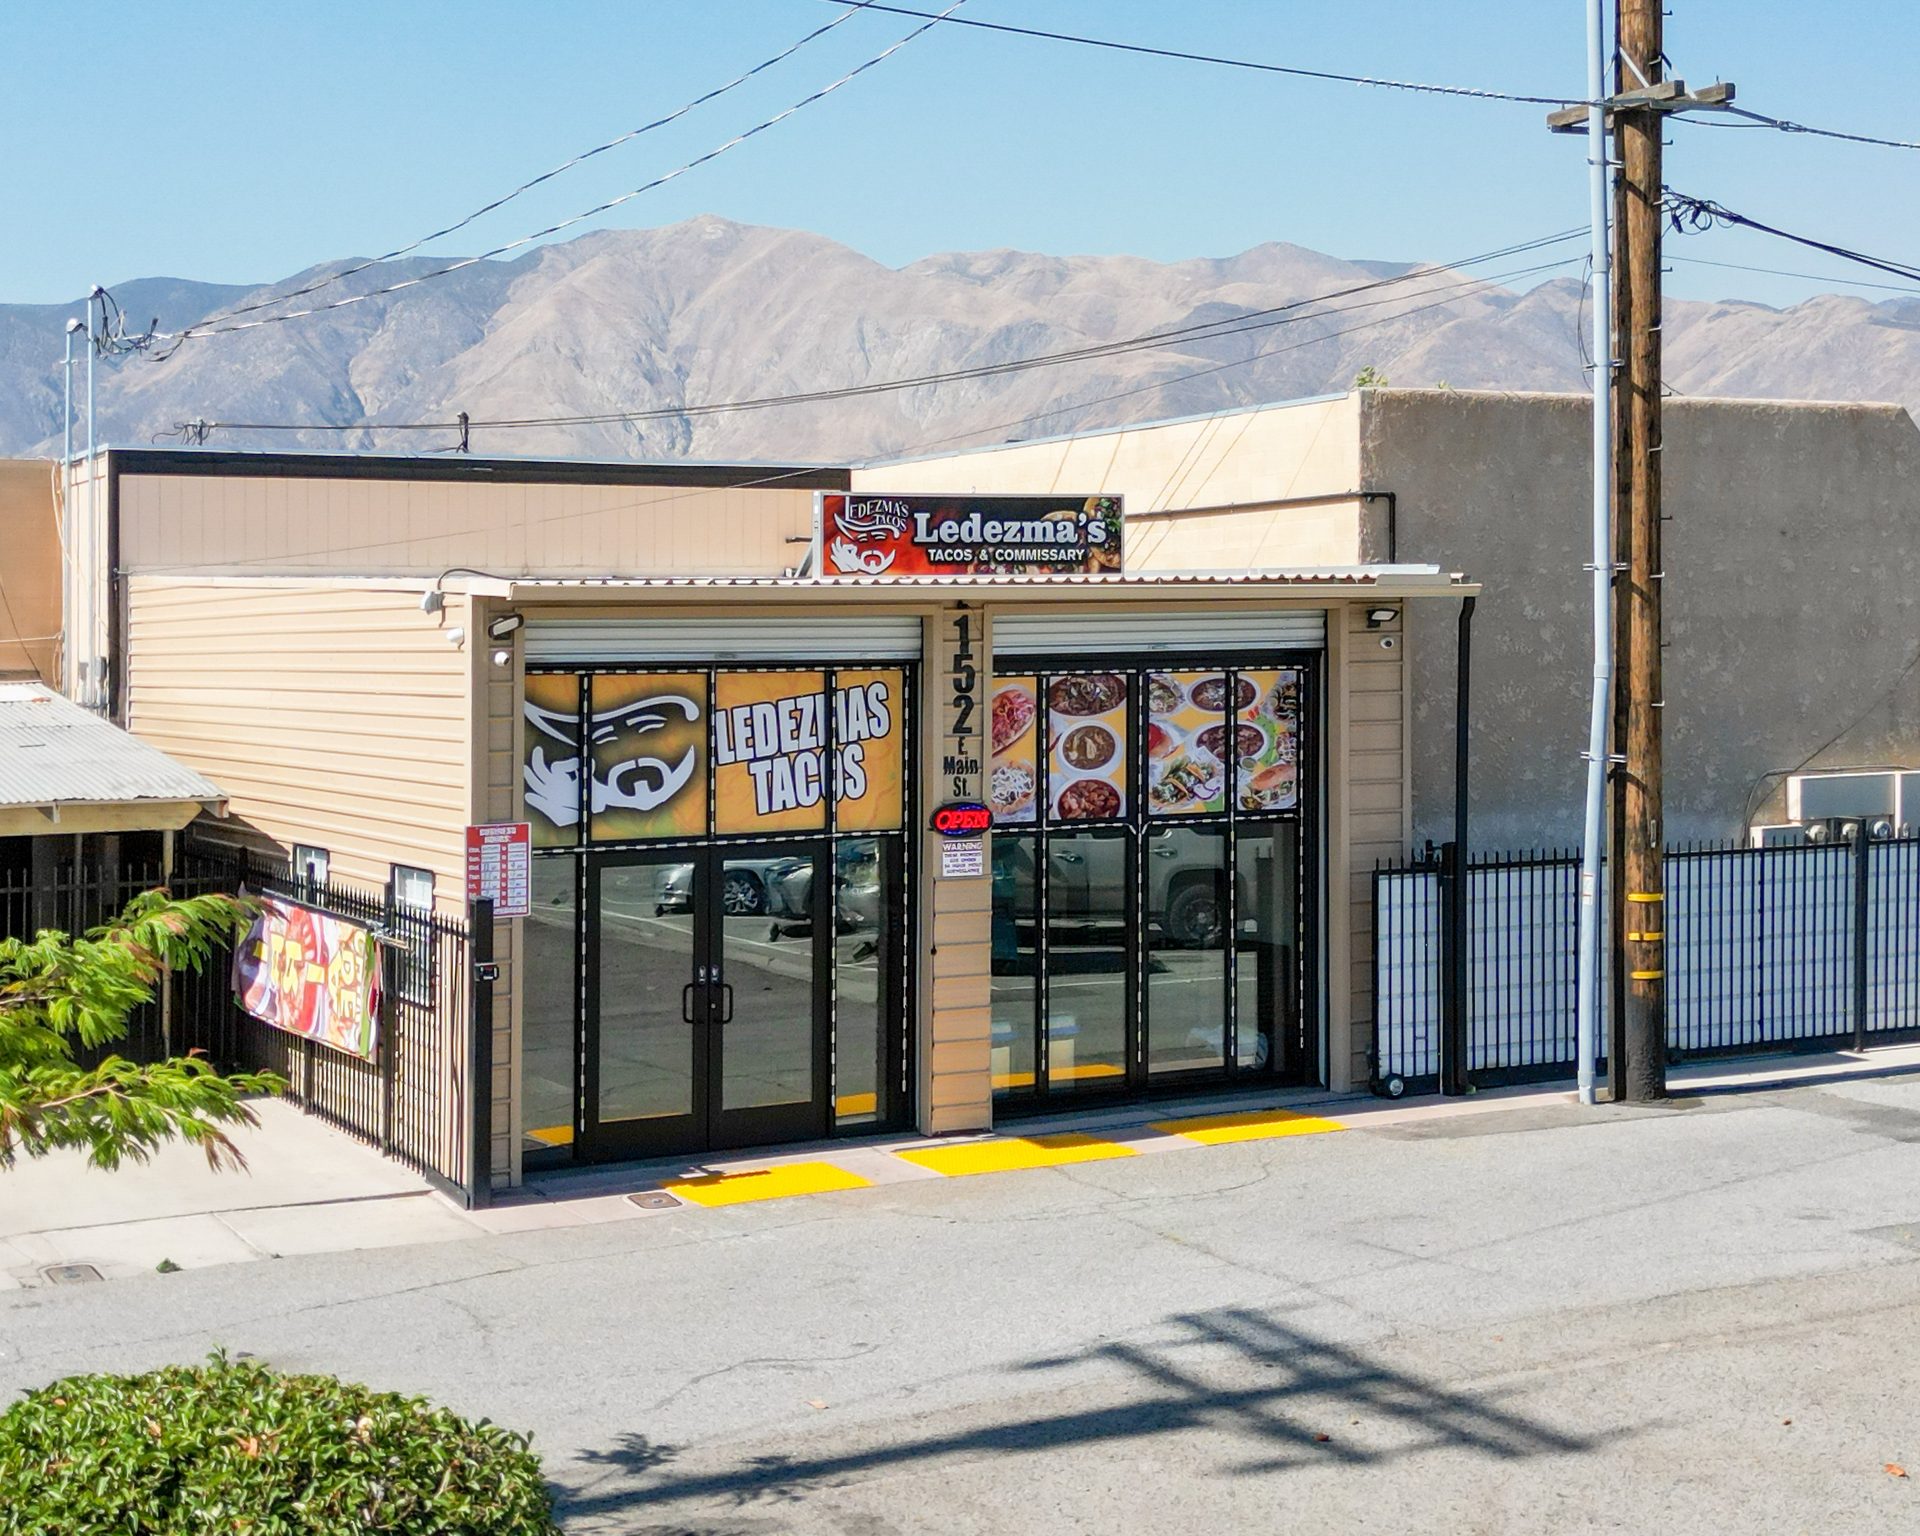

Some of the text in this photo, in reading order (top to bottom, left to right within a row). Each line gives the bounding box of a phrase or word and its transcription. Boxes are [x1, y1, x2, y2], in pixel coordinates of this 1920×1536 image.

[845, 496, 909, 522] LEDEZMA'S
[873, 514, 907, 531] TACOS
[914, 513, 1106, 543] Ledezma's
[928, 549, 1085, 561] TACOS & COMMISSARY
[953, 615, 975, 734] 152
[958, 736, 968, 755] E.
[943, 756, 978, 775] Main
[953, 776, 971, 797] St.
[936, 811, 990, 830] OPEN
